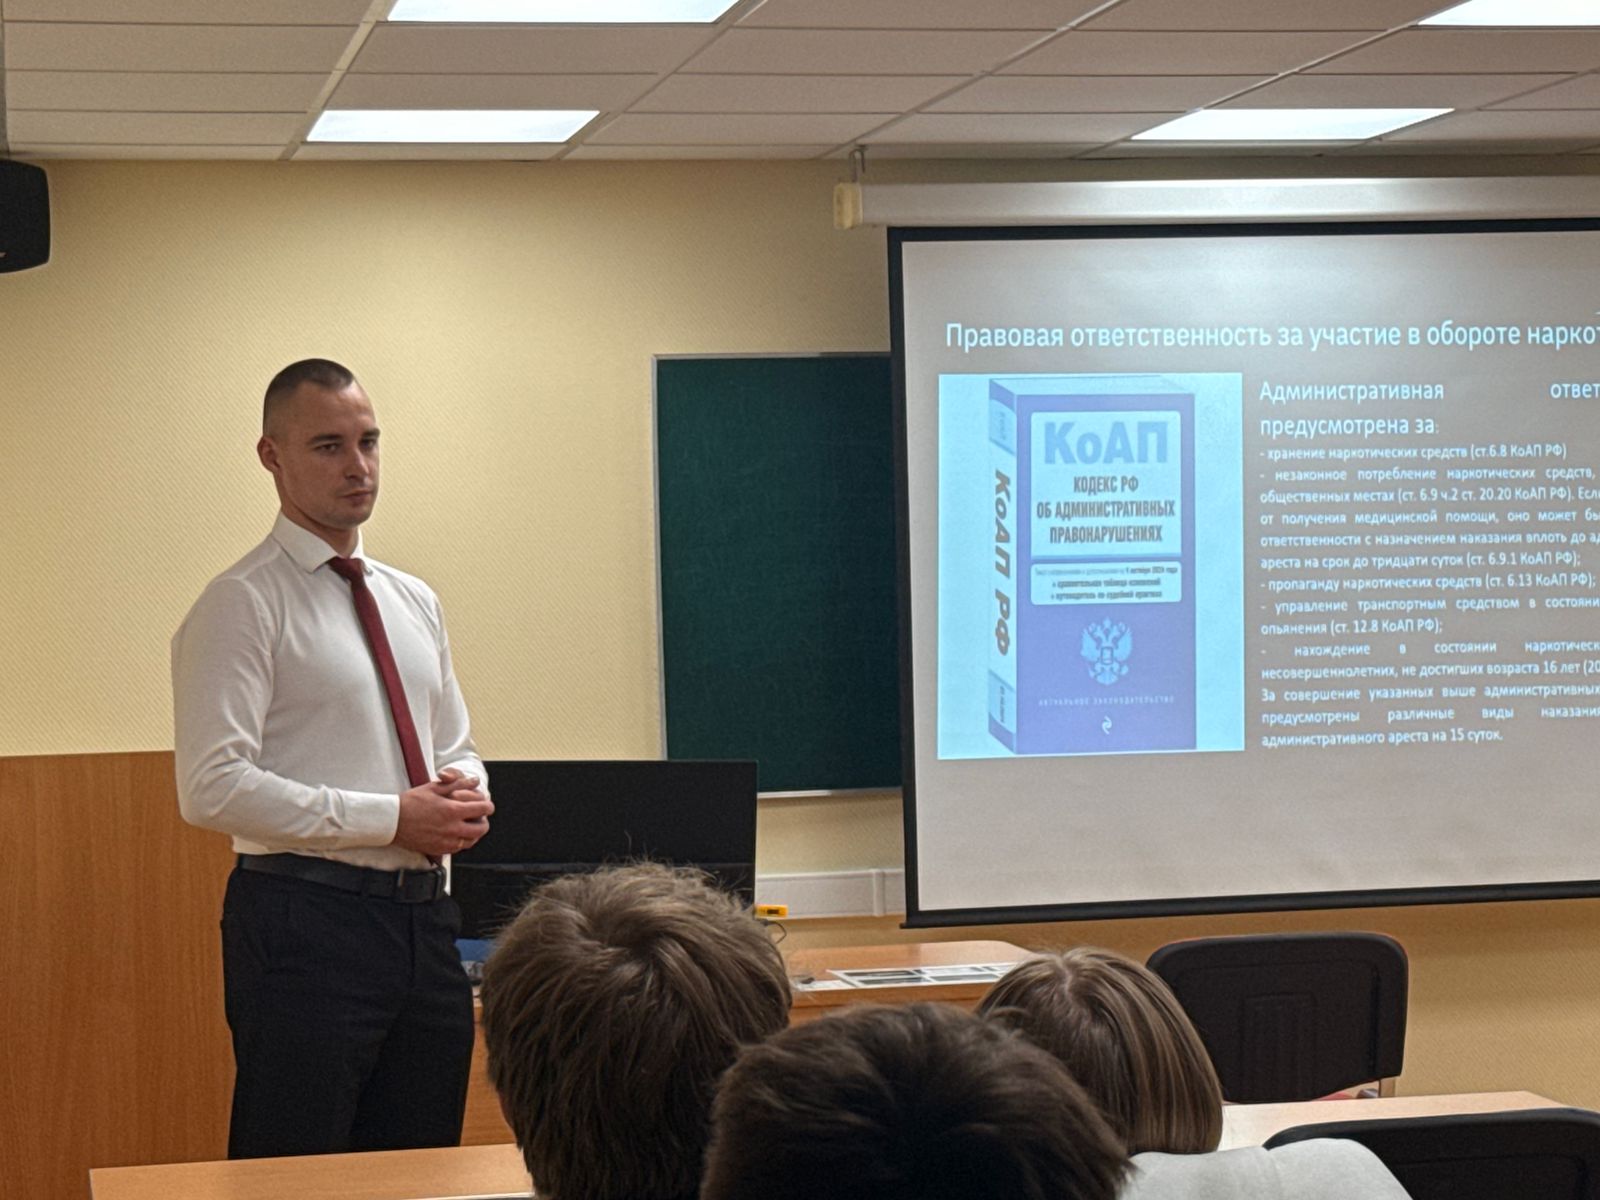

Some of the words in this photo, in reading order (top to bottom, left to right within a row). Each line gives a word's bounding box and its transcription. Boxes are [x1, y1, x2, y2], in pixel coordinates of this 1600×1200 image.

[946, 322, 1064, 352] Правовая
[1071, 325, 1271, 347] ответственность
[1278, 326, 1303, 346] за
[1310, 325, 1401, 351] участие
[1408, 326, 1420, 345] в
[1427, 321, 1521, 351] обороте
[1259, 381, 1444, 404] Административная
[1550, 383, 1600, 398] ответ
[1260, 418, 1409, 439] предусмотрена
[1415, 417, 1440, 434] за:
[1044, 421, 1168, 465] КоАП
[1267, 449, 1326, 462] хранение
[1329, 448, 1417, 462] наркотических
[1421, 447, 1467, 460] средств
[1510, 444, 1542, 458] КоАП
[1545, 443, 1567, 460] РФ)
[1275, 470, 1347, 481] незаконное
[1357, 467, 1437, 483] потребление
[1447, 468, 1536, 481] наркотических
[1545, 467, 1596, 480] средств,
[1073, 475, 1118, 495] КОДЕКС
[1121, 475, 1139, 492] РФ
[1260, 489, 1350, 505] общественных
[1353, 490, 1395, 501] местах
[1419, 487, 1438, 501] 6.9
[1515, 487, 1546, 500] КоАП
[1036, 502, 1051, 519] ОБ
[1055, 500, 1175, 521] АДМИНИСТРАТИВНЫХ
[1260, 514, 1273, 525] от
[1282, 513, 1347, 527] получения
[1355, 509, 1437, 526] медицинской
[1445, 511, 1499, 524] помощи,
[1507, 511, 1530, 521] оно
[1538, 510, 1577, 521] может
[995, 468, 1010, 579] КоАП
[1050, 525, 1162, 544] ПРАВОНАРУШЕНИЯХ
[1260, 534, 1361, 547] ответственности
[1365, 535, 1372, 546] с
[1375, 533, 1455, 546] назначением
[1460, 532, 1522, 544] наказания
[1526, 532, 1567, 544] вплоть
[1570, 532, 1586, 545] до
[1260, 557, 1301, 570] ареста
[1304, 557, 1319, 568] на
[1322, 556, 1350, 570] срок
[1352, 556, 1369, 569] до
[1372, 555, 1428, 570] тридцати
[1431, 555, 1463, 568] суток
[1488, 551, 1517, 566] 6.9.1
[1520, 551, 1551, 565] КоАП
[1268, 578, 1339, 593] пропаганду
[1343, 577, 1432, 591] наркотических
[1435, 576, 1482, 589] средств
[1507, 572, 1533, 587] 6.13
[1535, 572, 1567, 586] КоАП
[1275, 600, 1348, 614] управление
[1357, 599, 1446, 613] транспортным
[1456, 598, 1520, 612] средством
[1529, 598, 1536, 608] в
[995, 588, 1010, 656] РФ
[1260, 623, 1327, 635] опьянения
[1353, 619, 1379, 633] 12.8
[1382, 618, 1414, 633] КоАП
[1294, 644, 1371, 658] нахождение
[1399, 644, 1406, 654] в
[1434, 642, 1497, 653] состоянии
[1261, 665, 1398, 681] несовершеннолетних,
[1402, 666, 1416, 676] не
[1487, 663, 1540, 677] возраста
[1543, 660, 1557, 674] 16
[1560, 662, 1580, 674] лет
[1261, 688, 1276, 701] За
[1284, 688, 1360, 703] совершение
[1369, 687, 1434, 702] указанных
[1442, 686, 1477, 697] выше
[1484, 684, 1600, 699] административных
[1261, 711, 1360, 727] предусмотрены
[1388, 708, 1455, 724] различные
[1482, 707, 1514, 720] виды
[1261, 731, 1385, 747] административного
[1388, 731, 1429, 746] ареста
[1432, 730, 1447, 742] на
[1450, 728, 1464, 742] 15
[1467, 729, 1503, 744] суток.
